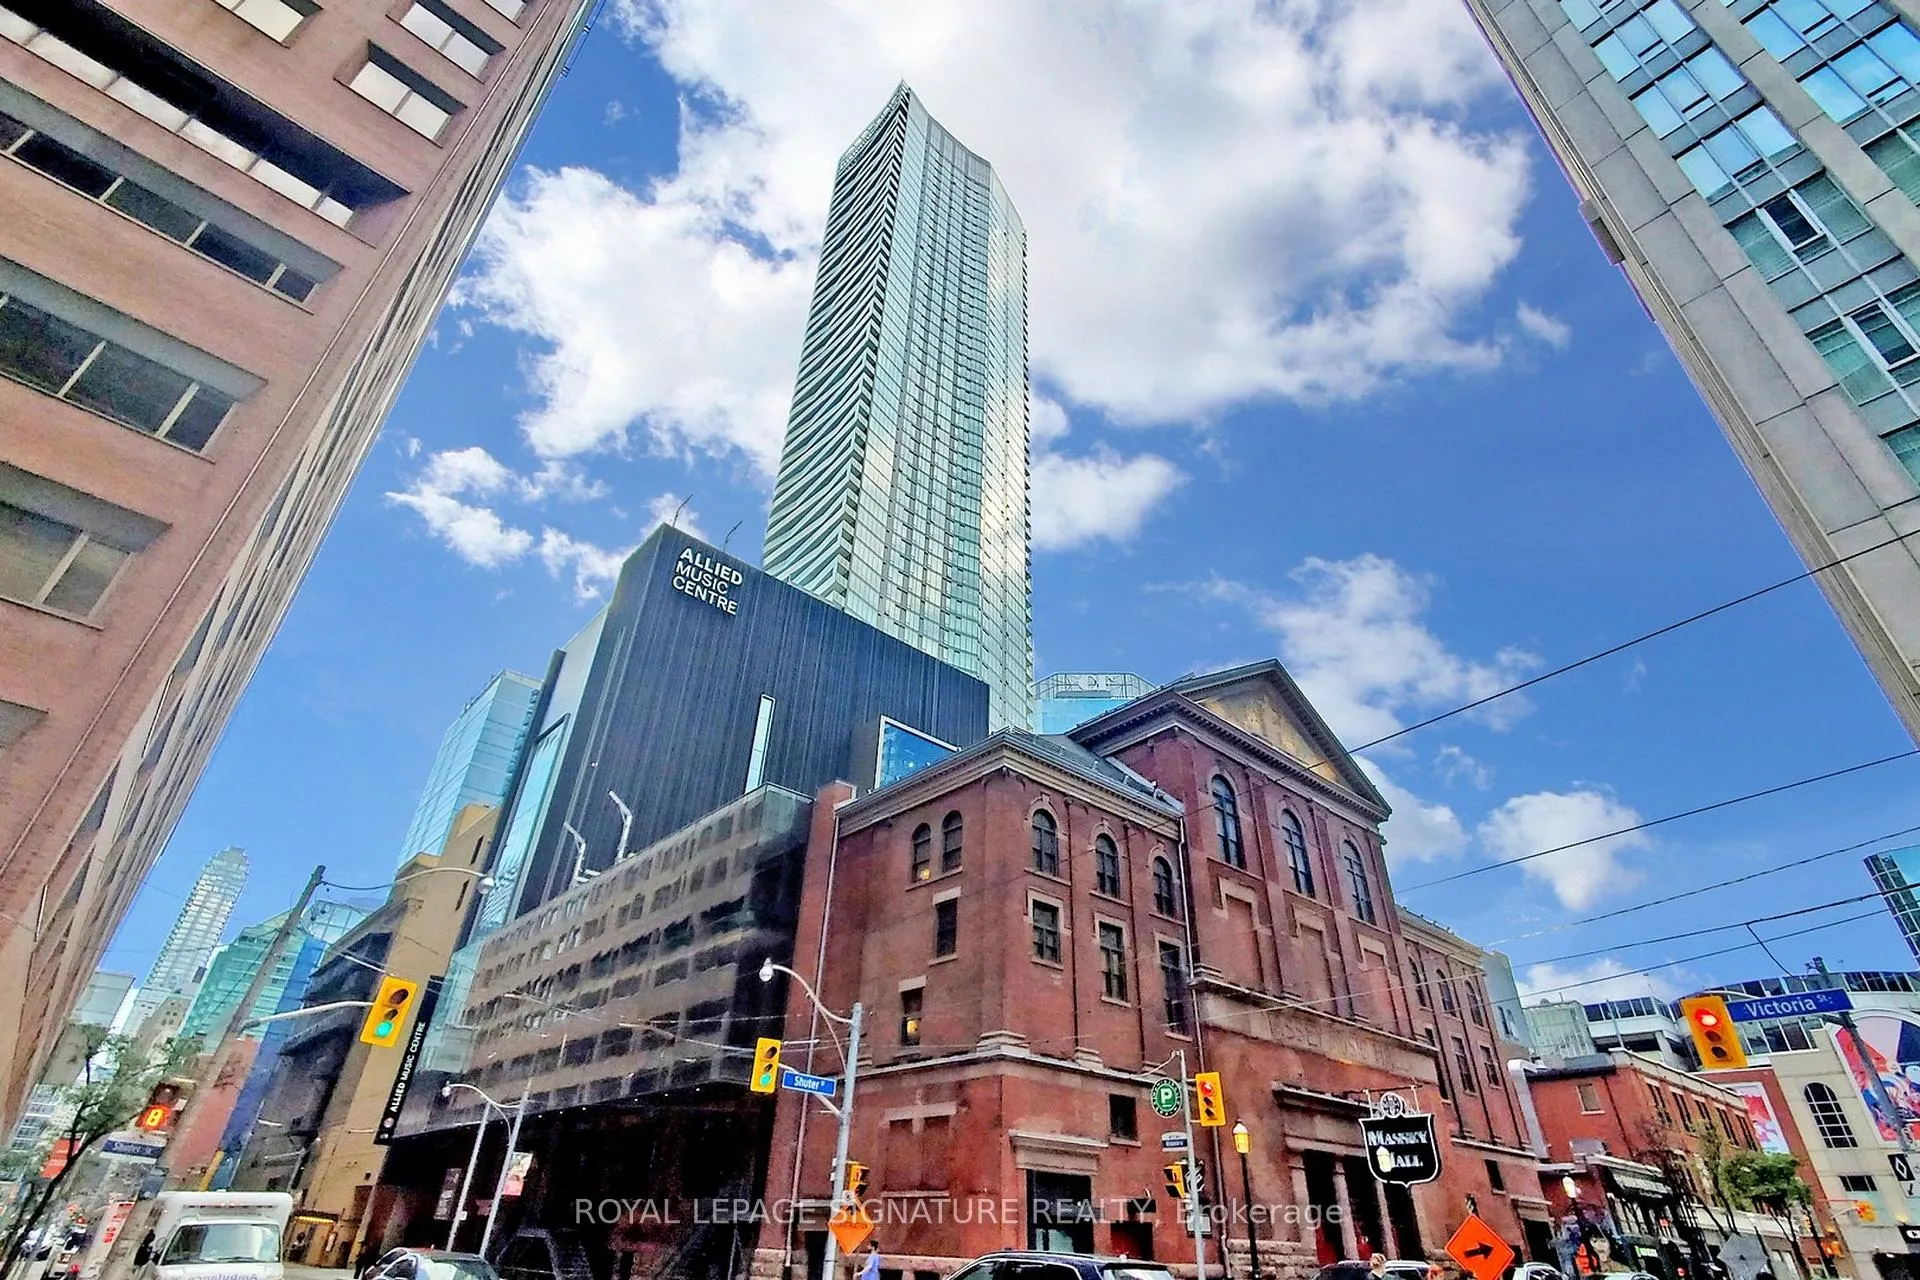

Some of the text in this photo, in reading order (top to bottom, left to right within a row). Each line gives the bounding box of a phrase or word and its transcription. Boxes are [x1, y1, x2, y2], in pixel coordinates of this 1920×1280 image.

[675, 560, 728, 595] MUSIC
[680, 547, 743, 585] ALLIED
[672, 575, 738, 615] CENTRE
[1745, 998, 1817, 1017] Victoria
[390, 1021, 425, 1113] ALLIED MUSIC CENTRE
[794, 1075, 820, 1090] Shuter
[1160, 1087, 1173, 1104] P
